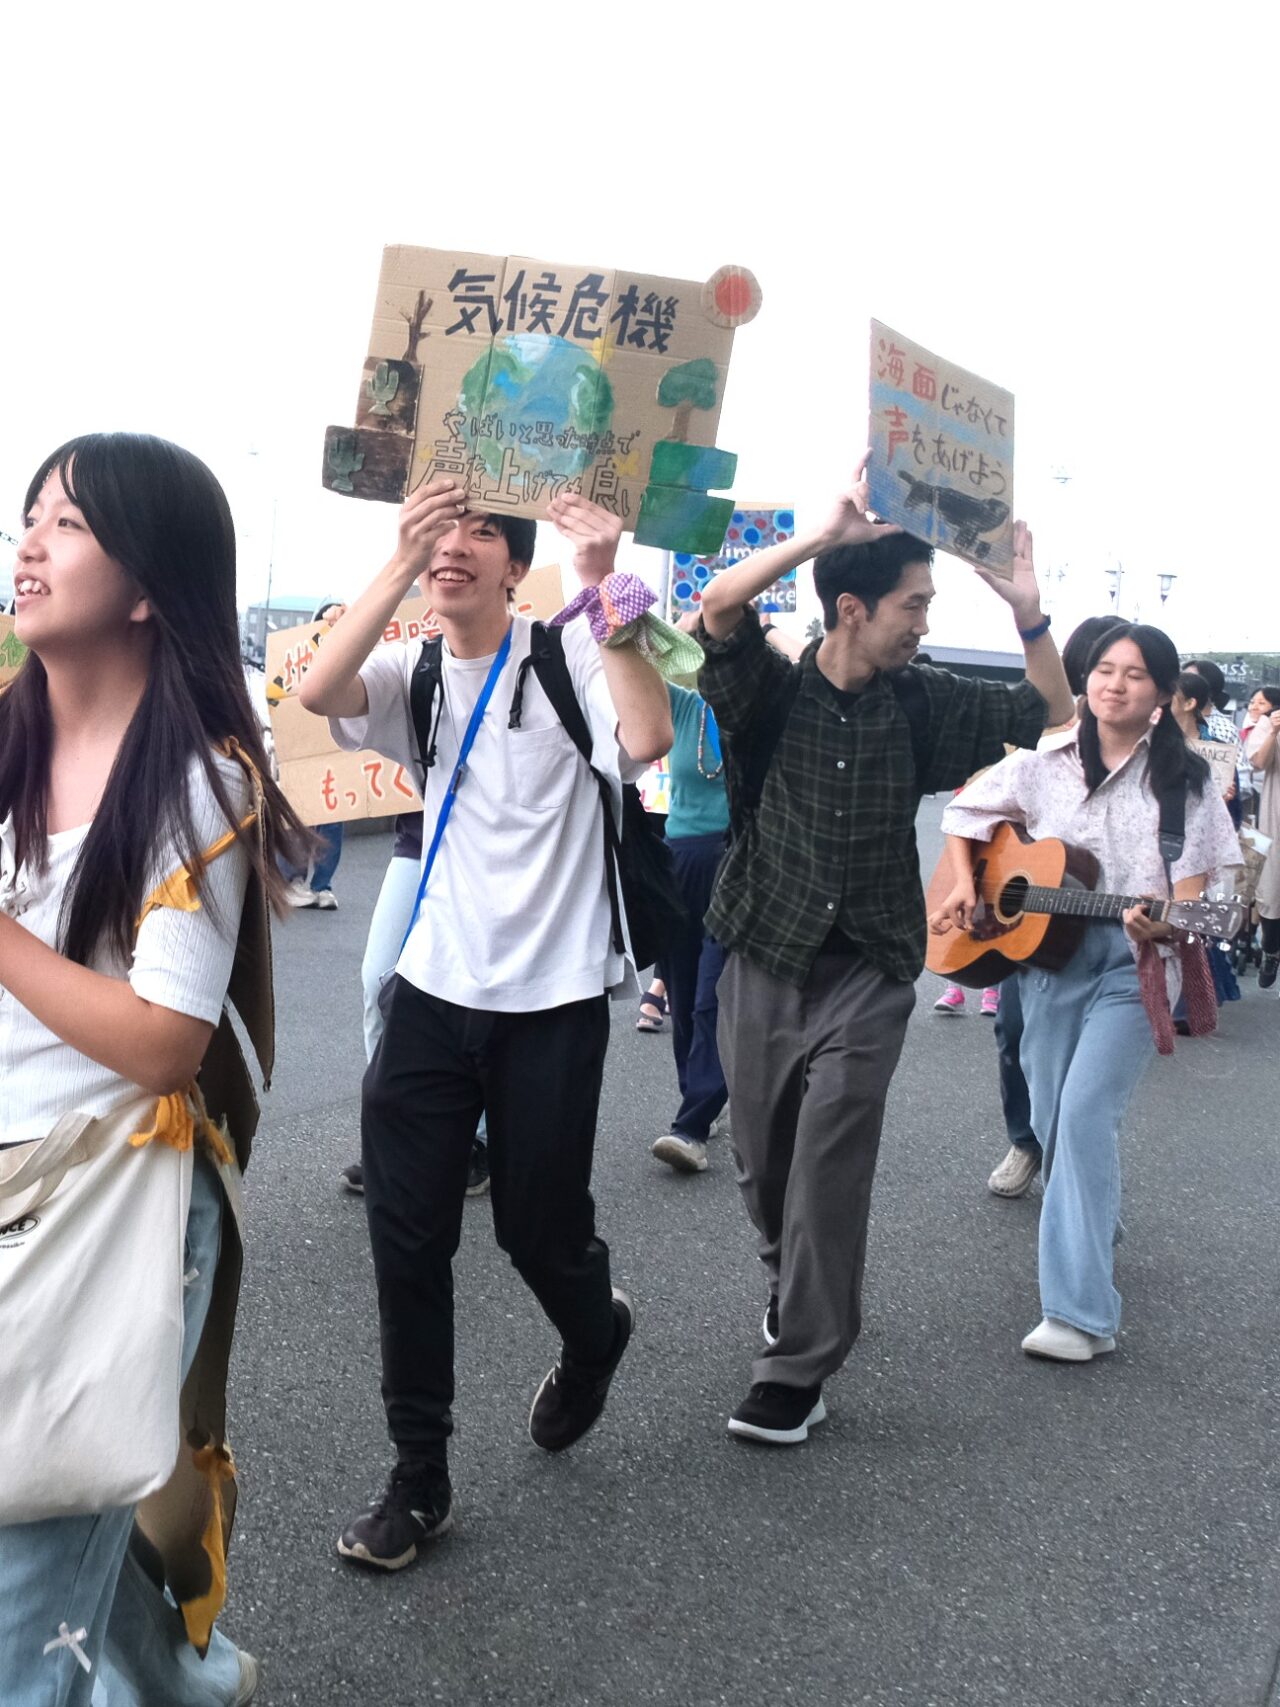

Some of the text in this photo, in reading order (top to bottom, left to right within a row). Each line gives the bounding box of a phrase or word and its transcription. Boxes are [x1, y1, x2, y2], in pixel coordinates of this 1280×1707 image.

[444, 268, 680, 353] 気候危機
[877, 338, 1008, 438] 海面じゃなくて
[884, 405, 1007, 496] 声をあげよう
